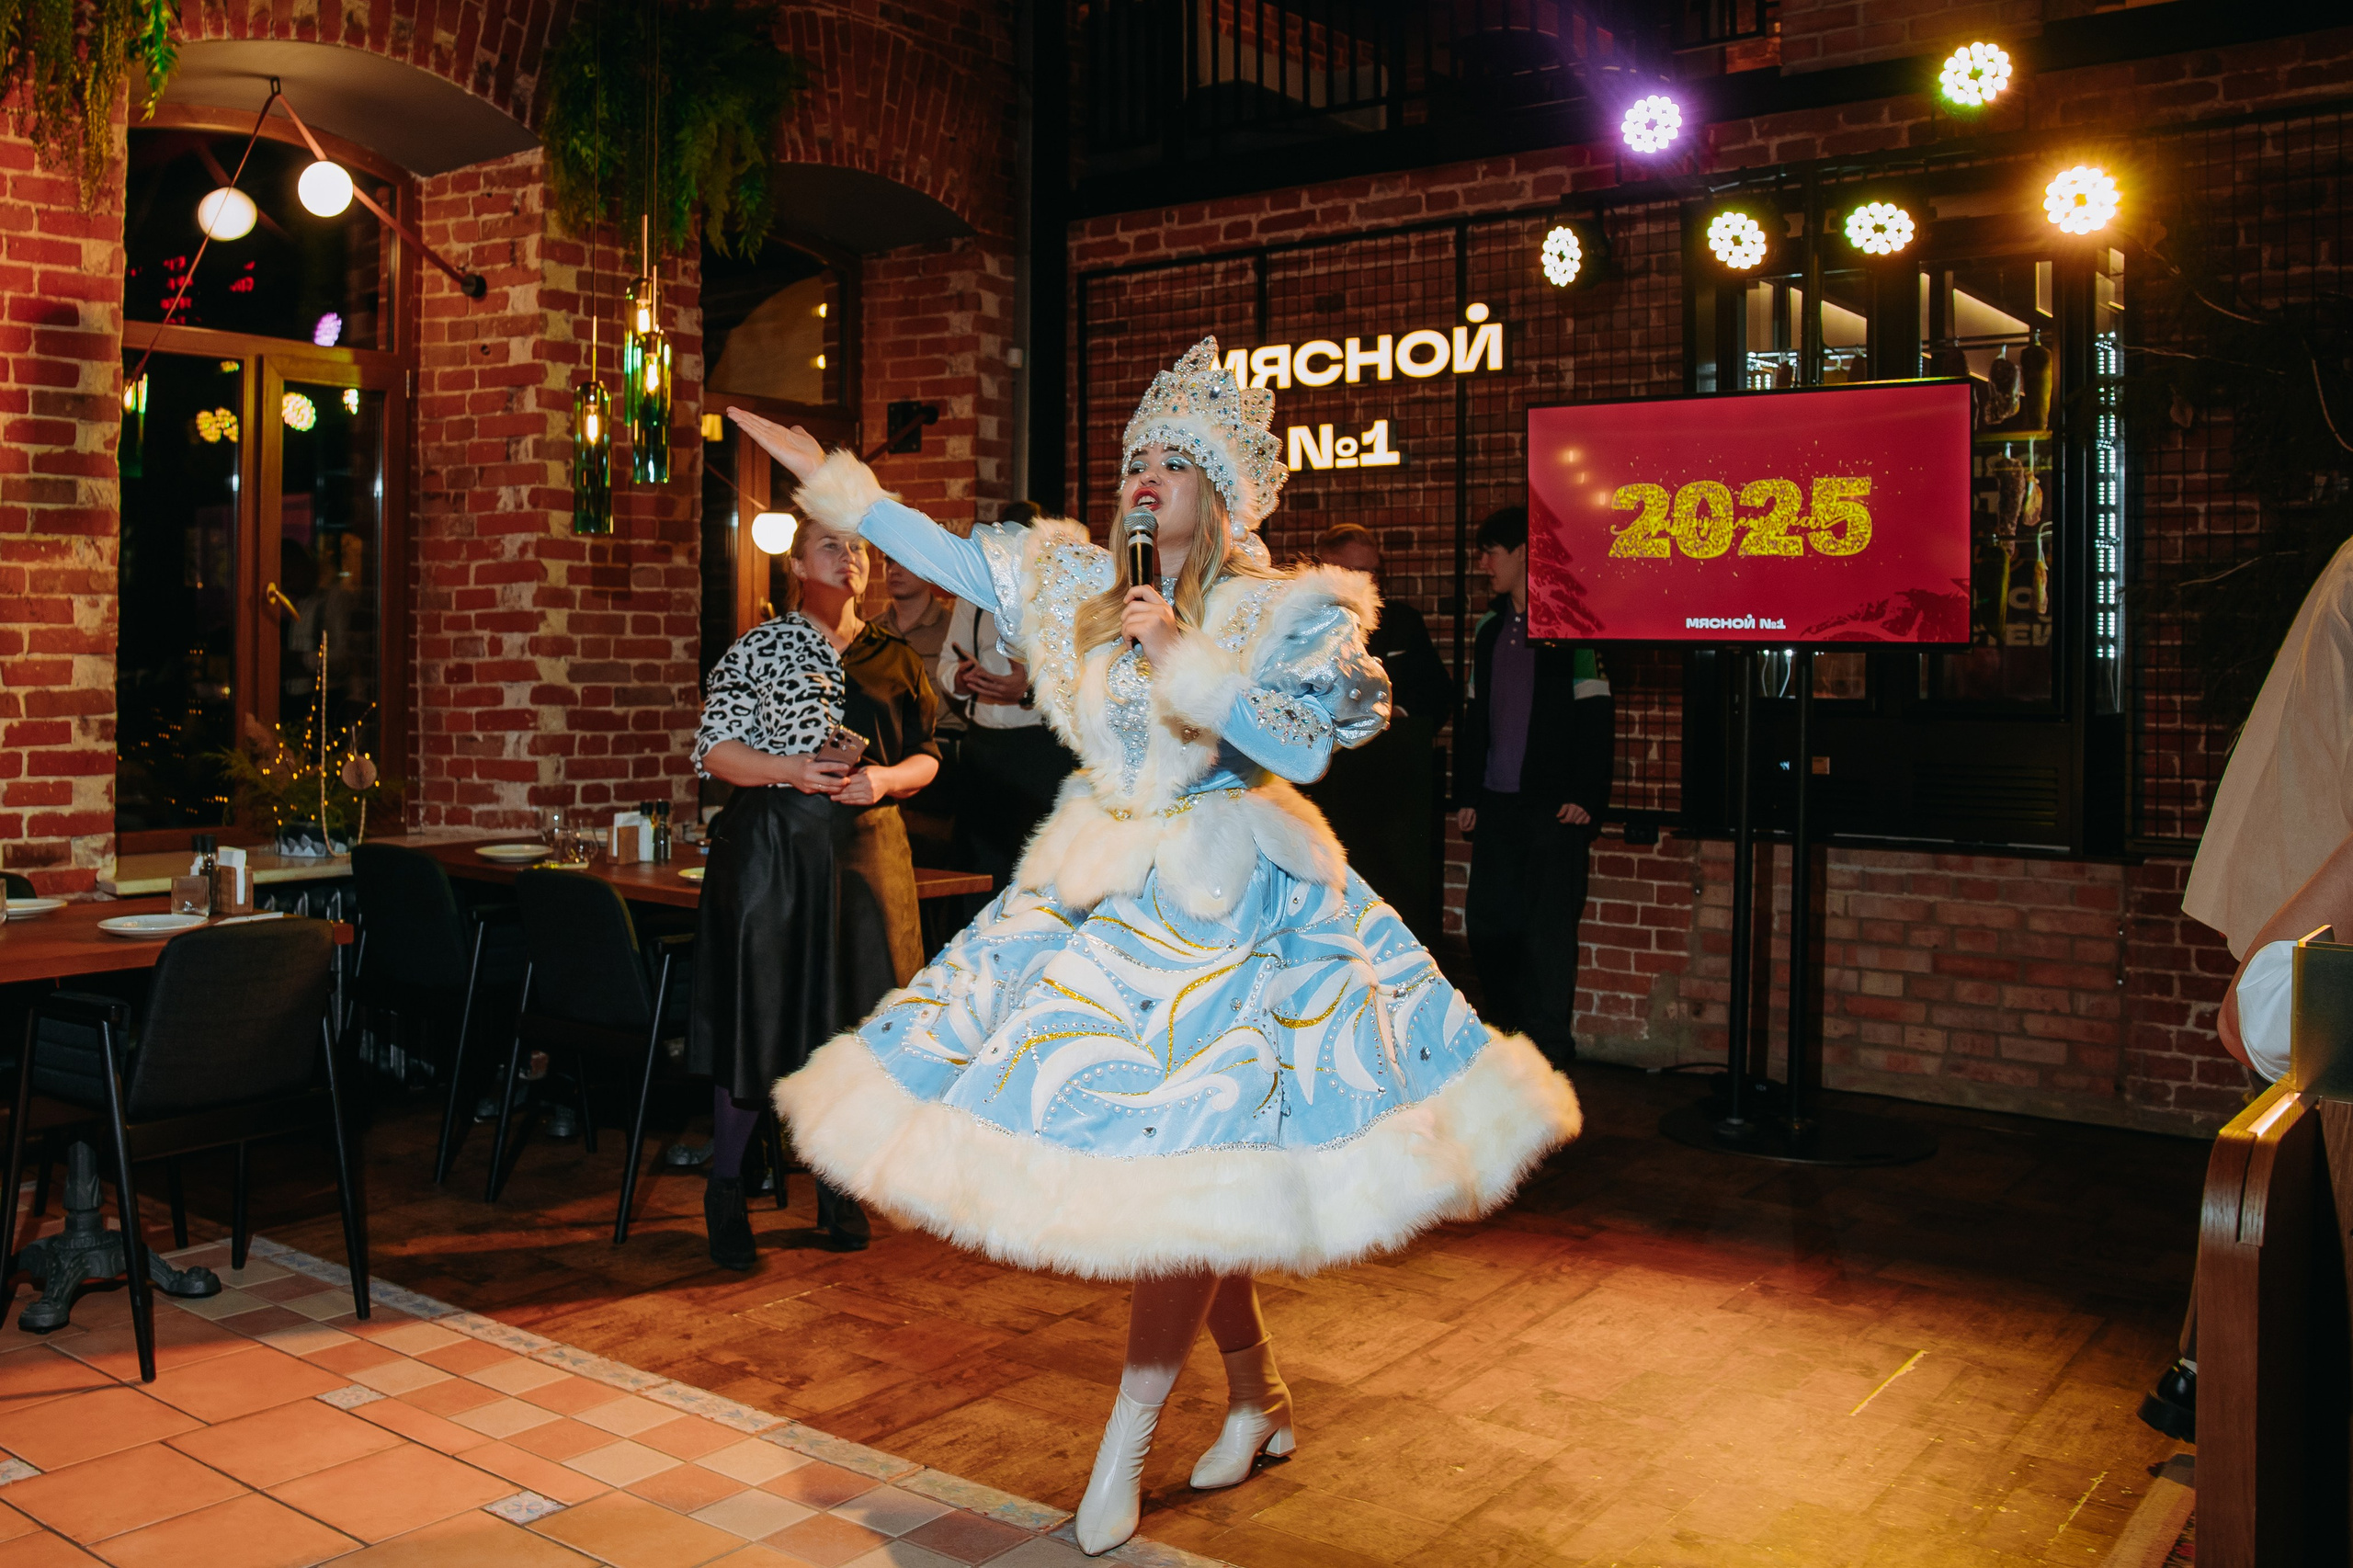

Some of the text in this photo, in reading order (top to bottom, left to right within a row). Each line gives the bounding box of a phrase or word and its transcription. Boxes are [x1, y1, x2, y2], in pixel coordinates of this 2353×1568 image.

[1288, 419, 1400, 471] №1
[1608, 477, 1872, 558] 2025
[1686, 613, 1786, 630] МЯСНОЙ №1
